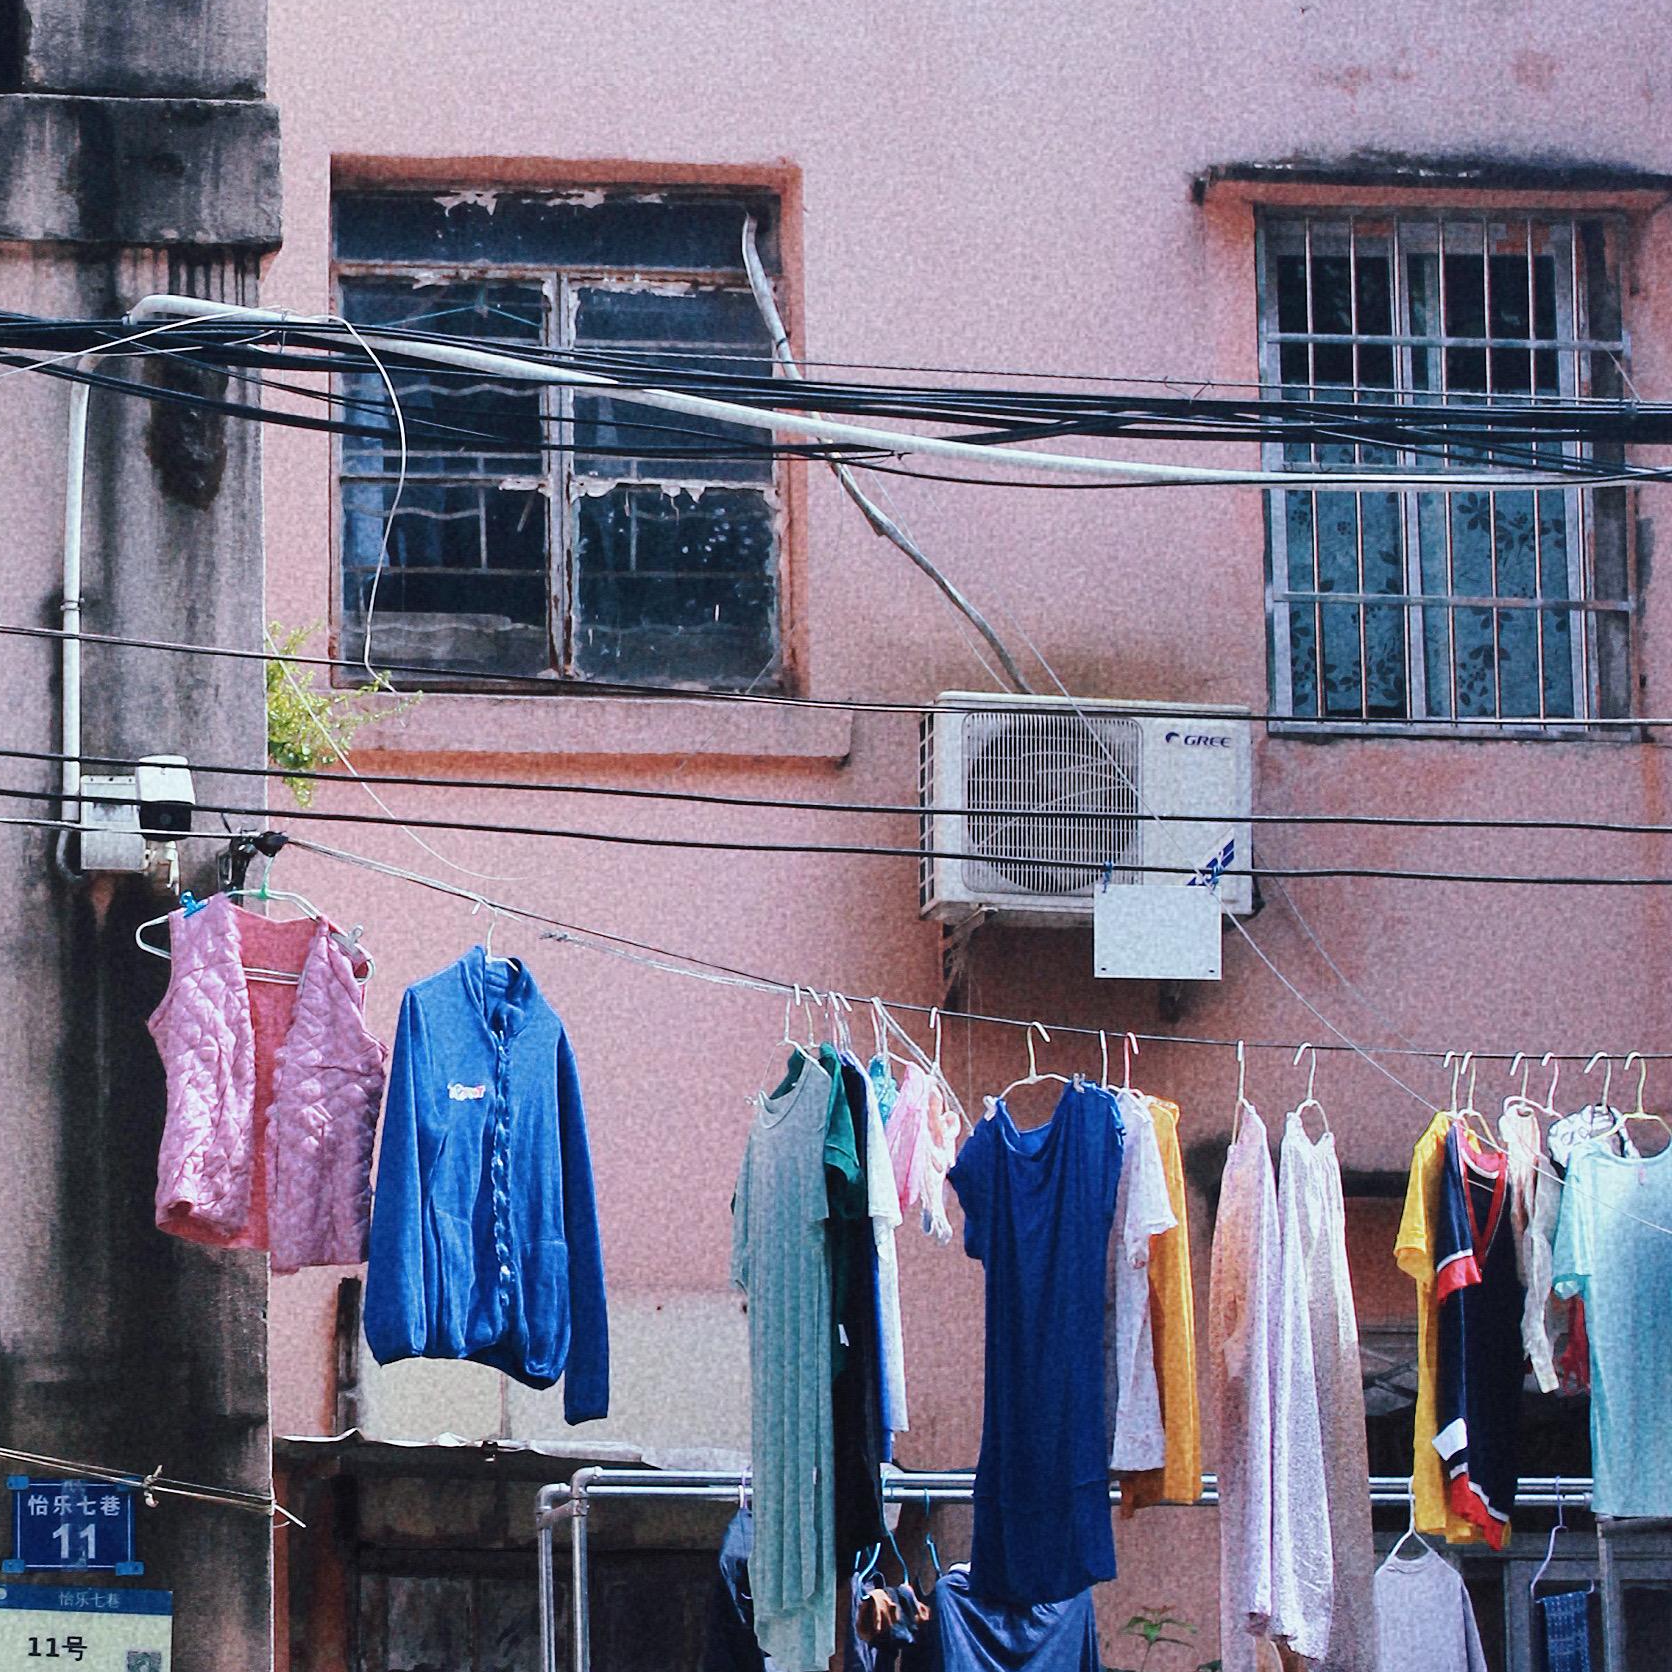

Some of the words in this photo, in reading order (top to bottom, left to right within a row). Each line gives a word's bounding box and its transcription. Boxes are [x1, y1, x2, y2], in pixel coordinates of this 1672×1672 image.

[1184, 735, 1232, 748] GREE
[27, 1494, 121, 1517] 怡乐七巷
[52, 1523, 96, 1559] 11
[58, 1591, 120, 1609] 怡乐七巷
[28, 1636, 88, 1662] 11号
